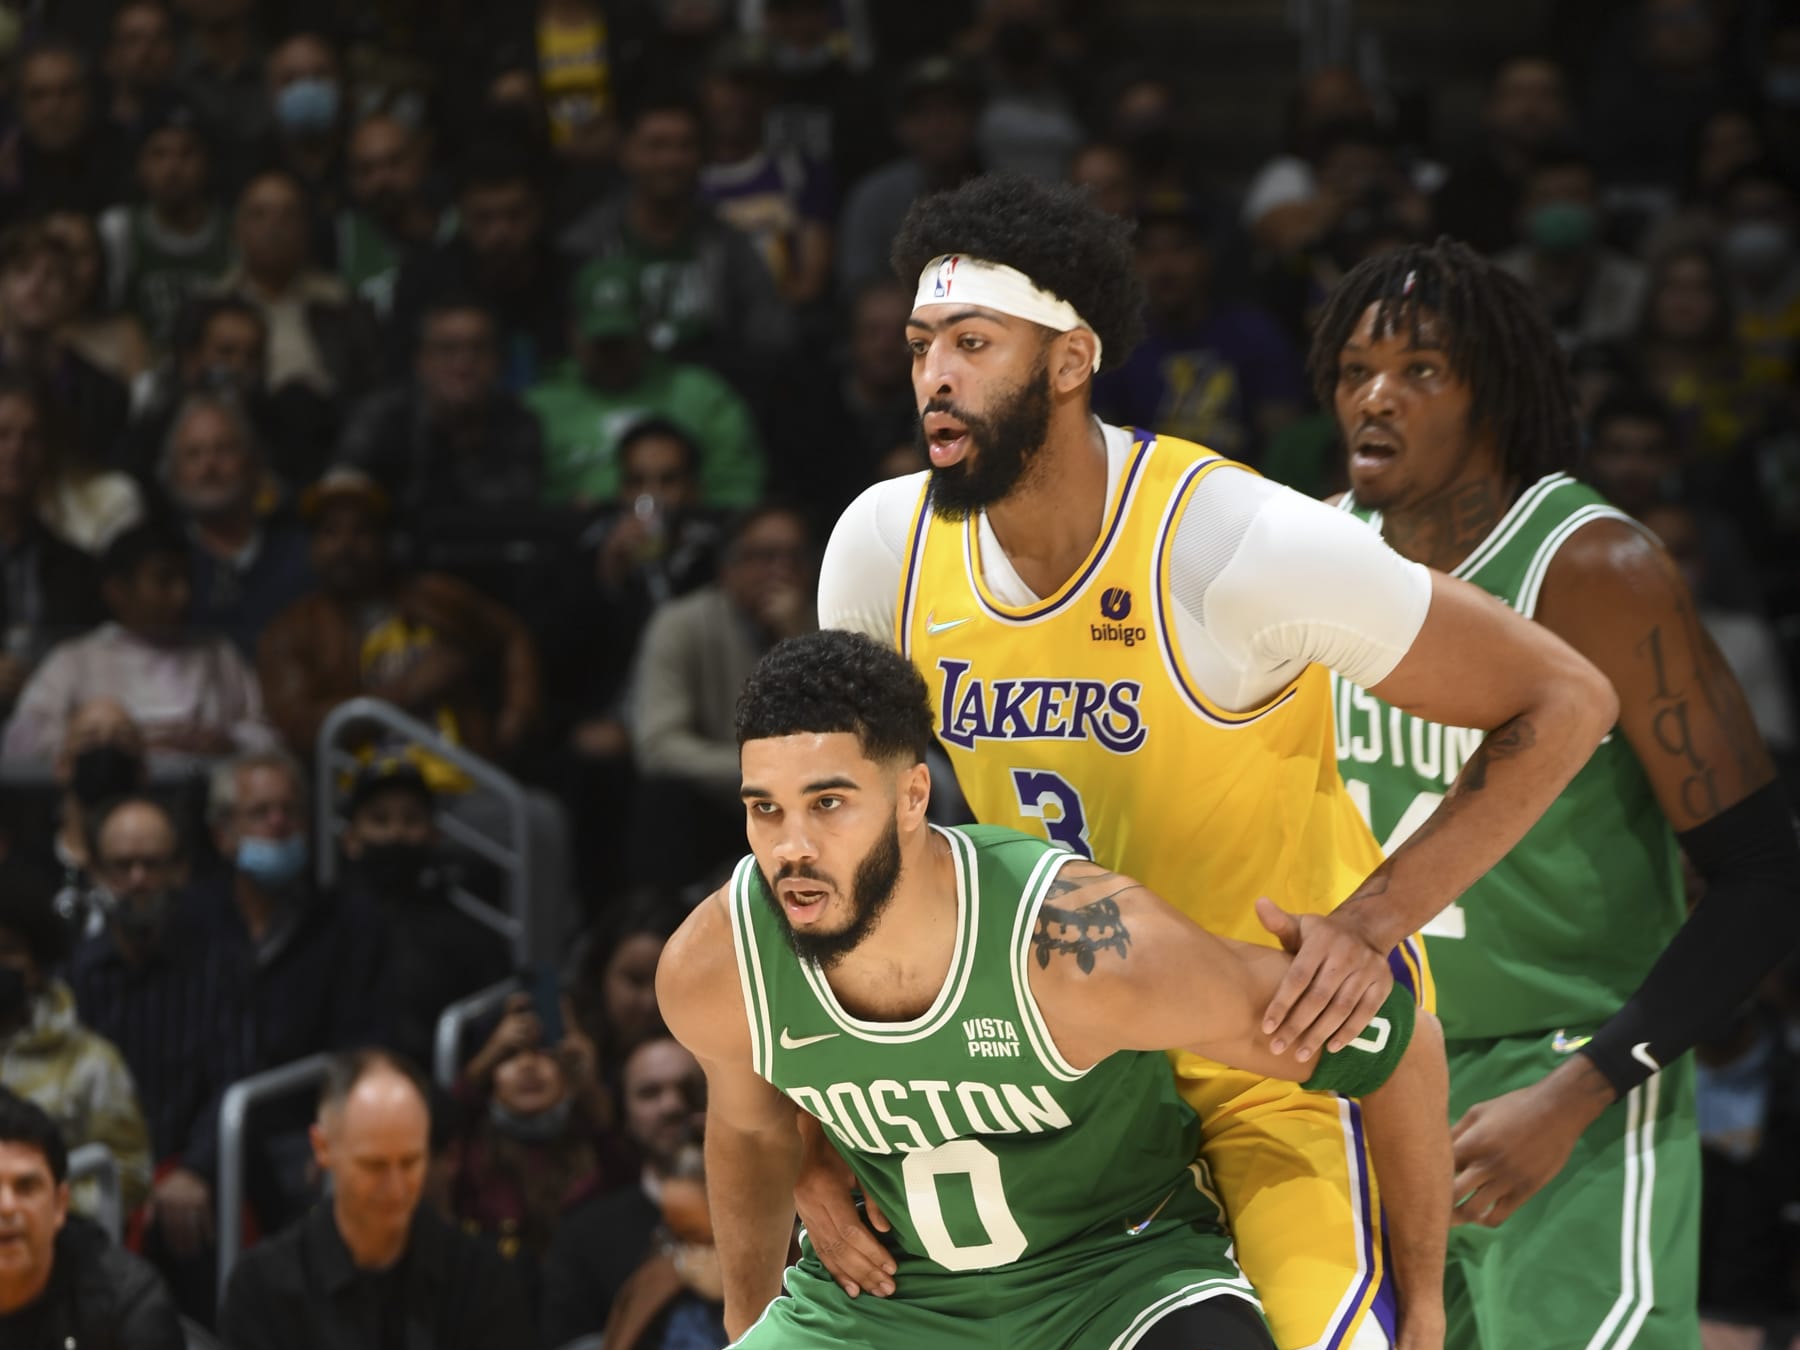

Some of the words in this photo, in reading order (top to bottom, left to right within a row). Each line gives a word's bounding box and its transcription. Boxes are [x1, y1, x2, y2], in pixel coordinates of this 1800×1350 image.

[1091, 624, 1146, 647] bibigo
[936, 656, 1149, 755] LAKERS
[1009, 767, 1095, 862] 3
[962, 1018, 1019, 1042] VISTA
[967, 1041, 1021, 1058] PRINT
[901, 1139, 1029, 1272] 0
